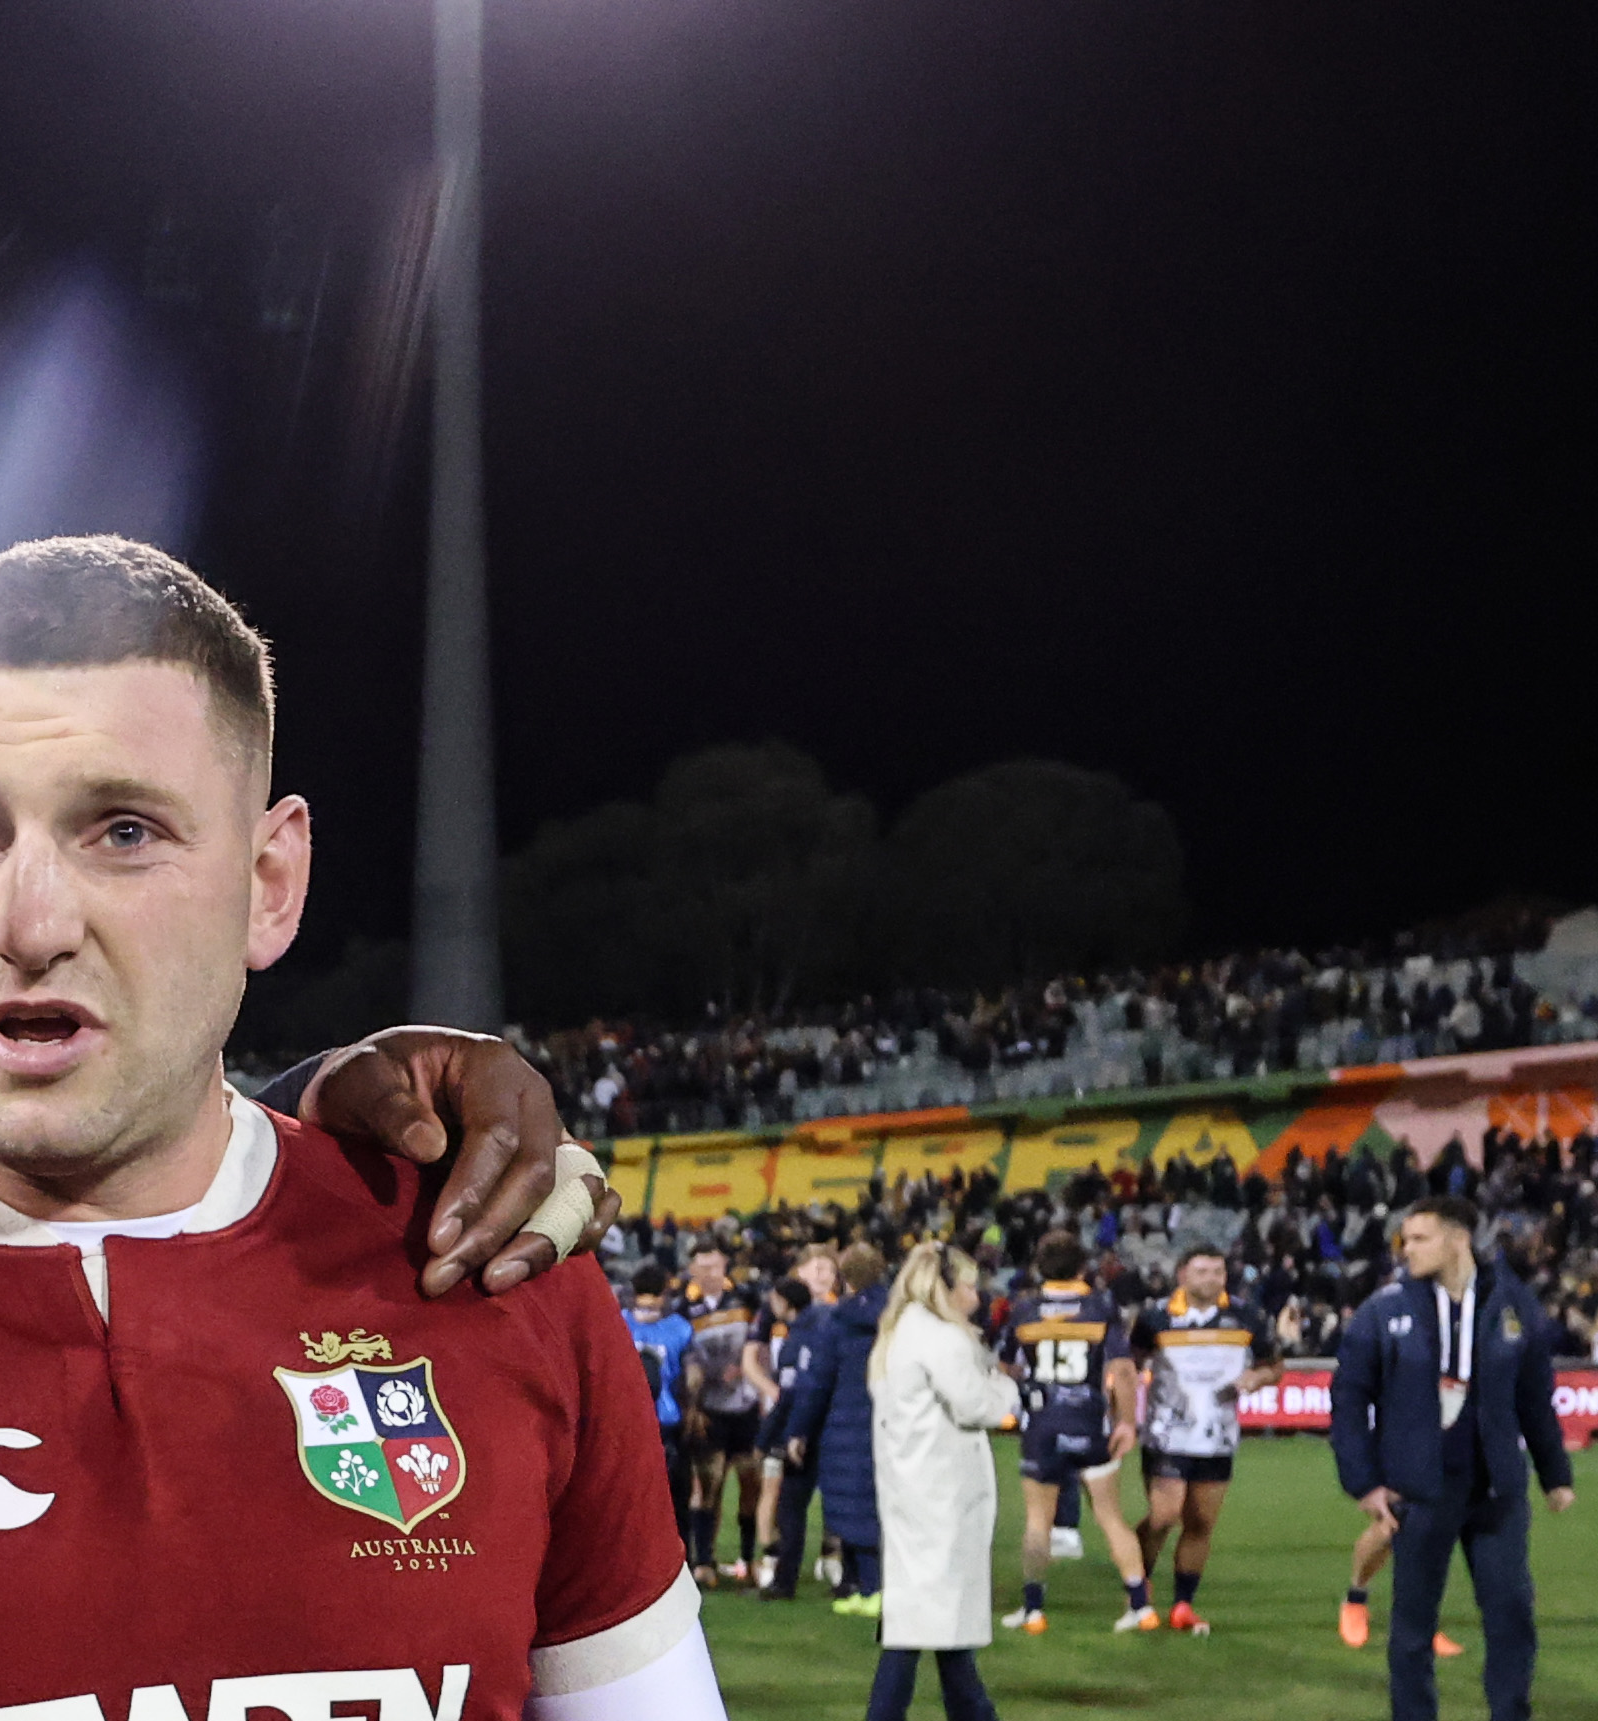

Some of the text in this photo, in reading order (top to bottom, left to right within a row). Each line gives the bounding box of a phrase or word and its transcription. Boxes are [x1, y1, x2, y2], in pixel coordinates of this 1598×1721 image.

[1034, 1339, 1089, 1384] 13
[350, 1538, 477, 1558] AUSTRALIA
[393, 1557, 449, 1572] 2025
